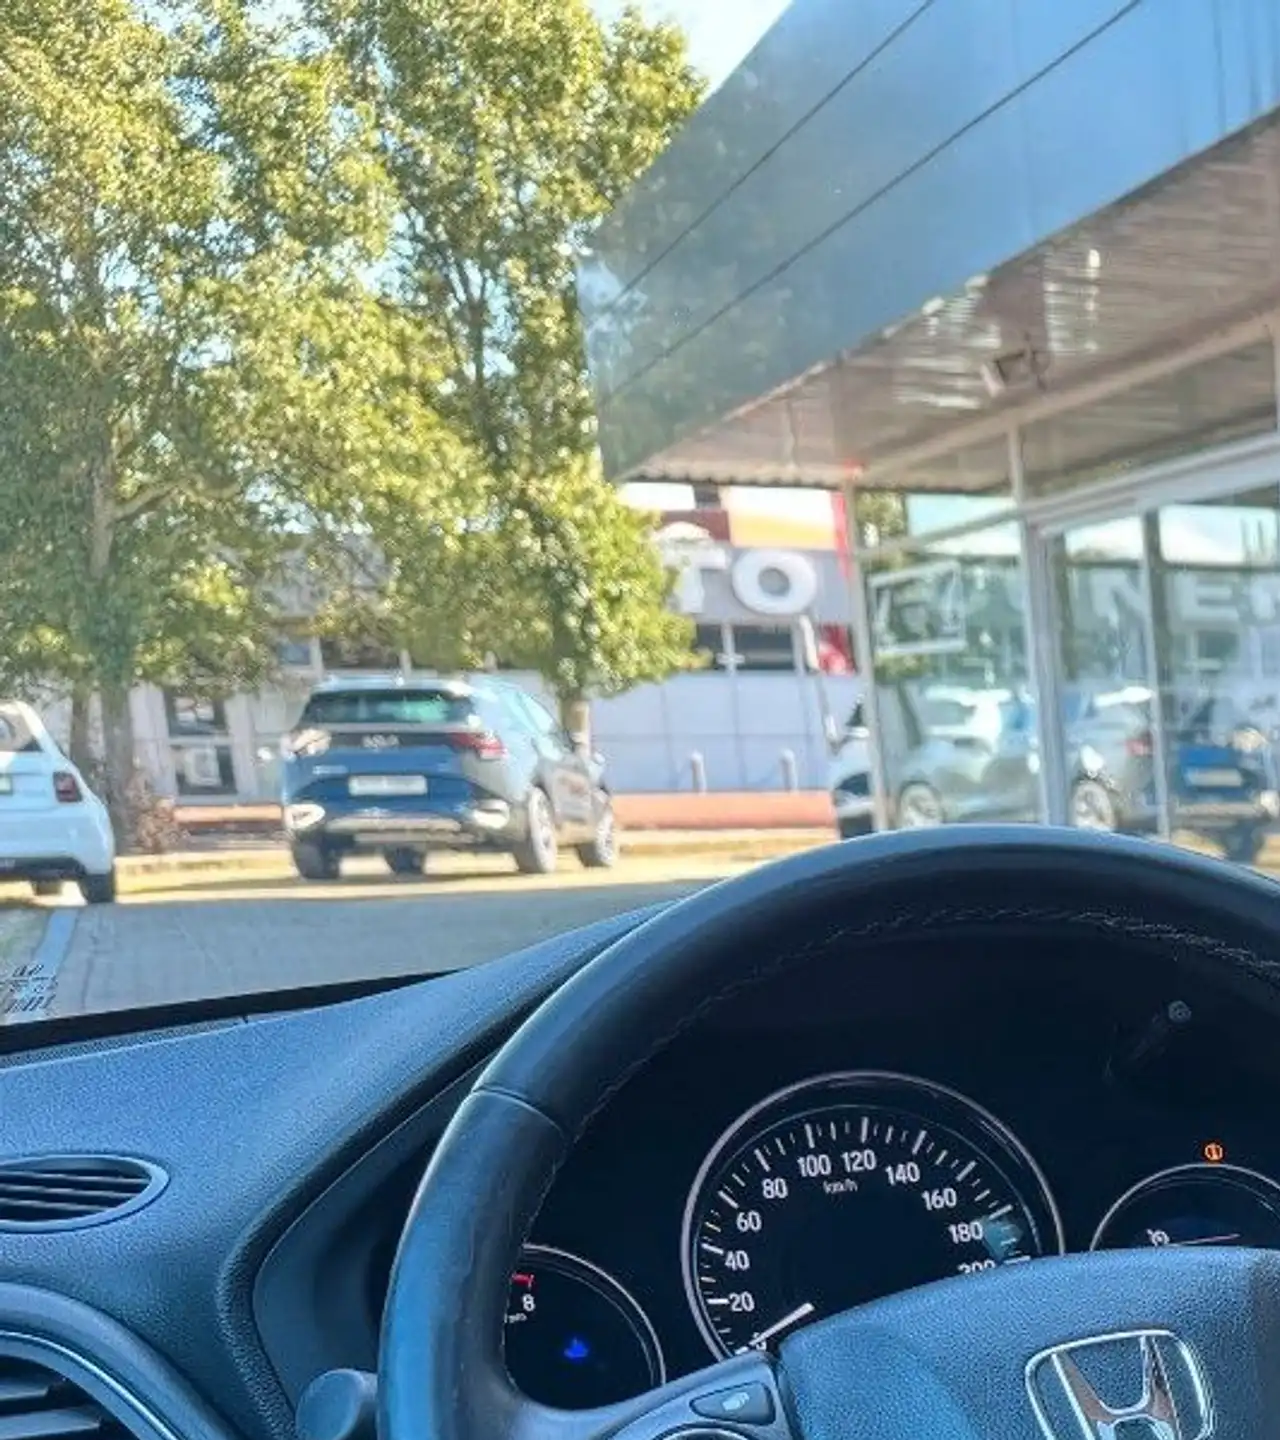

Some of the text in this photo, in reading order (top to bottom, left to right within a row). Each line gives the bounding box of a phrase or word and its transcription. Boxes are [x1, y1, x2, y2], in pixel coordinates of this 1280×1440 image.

[797, 1153, 832, 1177] 100
[840, 1148, 877, 1174] 120
[886, 1161, 920, 1187] 140
[762, 1178, 788, 1200] 80
[922, 1187, 958, 1211] 160
[736, 1211, 762, 1233] 60
[949, 1221, 984, 1244] 180
[724, 1250, 750, 1270] 40
[522, 1293, 536, 1312] 8
[729, 1292, 755, 1312] 20
